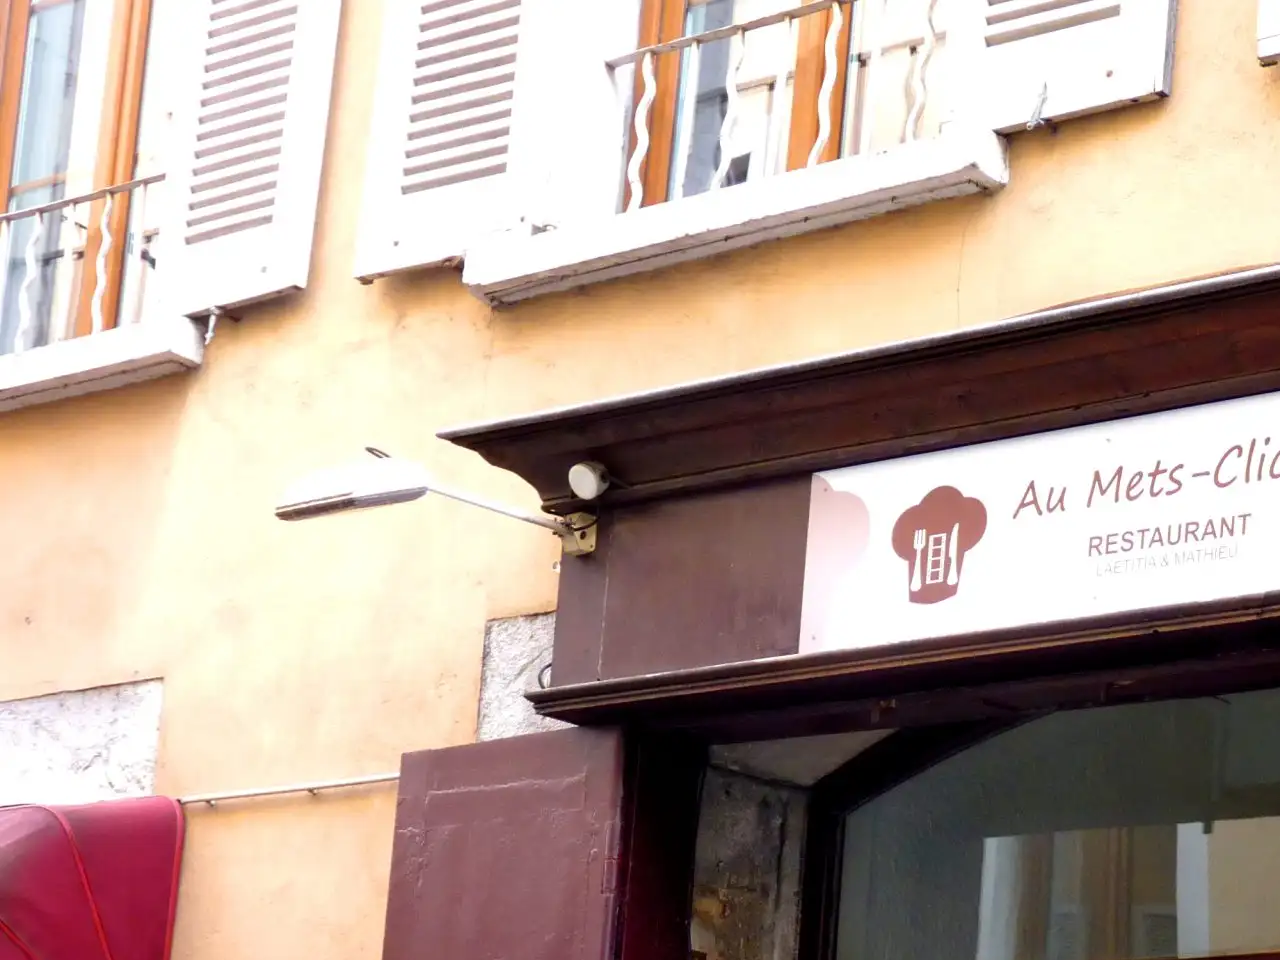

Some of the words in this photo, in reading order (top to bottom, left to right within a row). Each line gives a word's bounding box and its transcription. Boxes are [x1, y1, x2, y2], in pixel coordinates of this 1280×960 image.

[1013, 480, 1066, 519] Au
[1088, 513, 1251, 556] RESTAURANT
[1096, 557, 1156, 577] LAETITIA
[1161, 554, 1169, 567] &
[1175, 543, 1239, 566] MATHIEU
